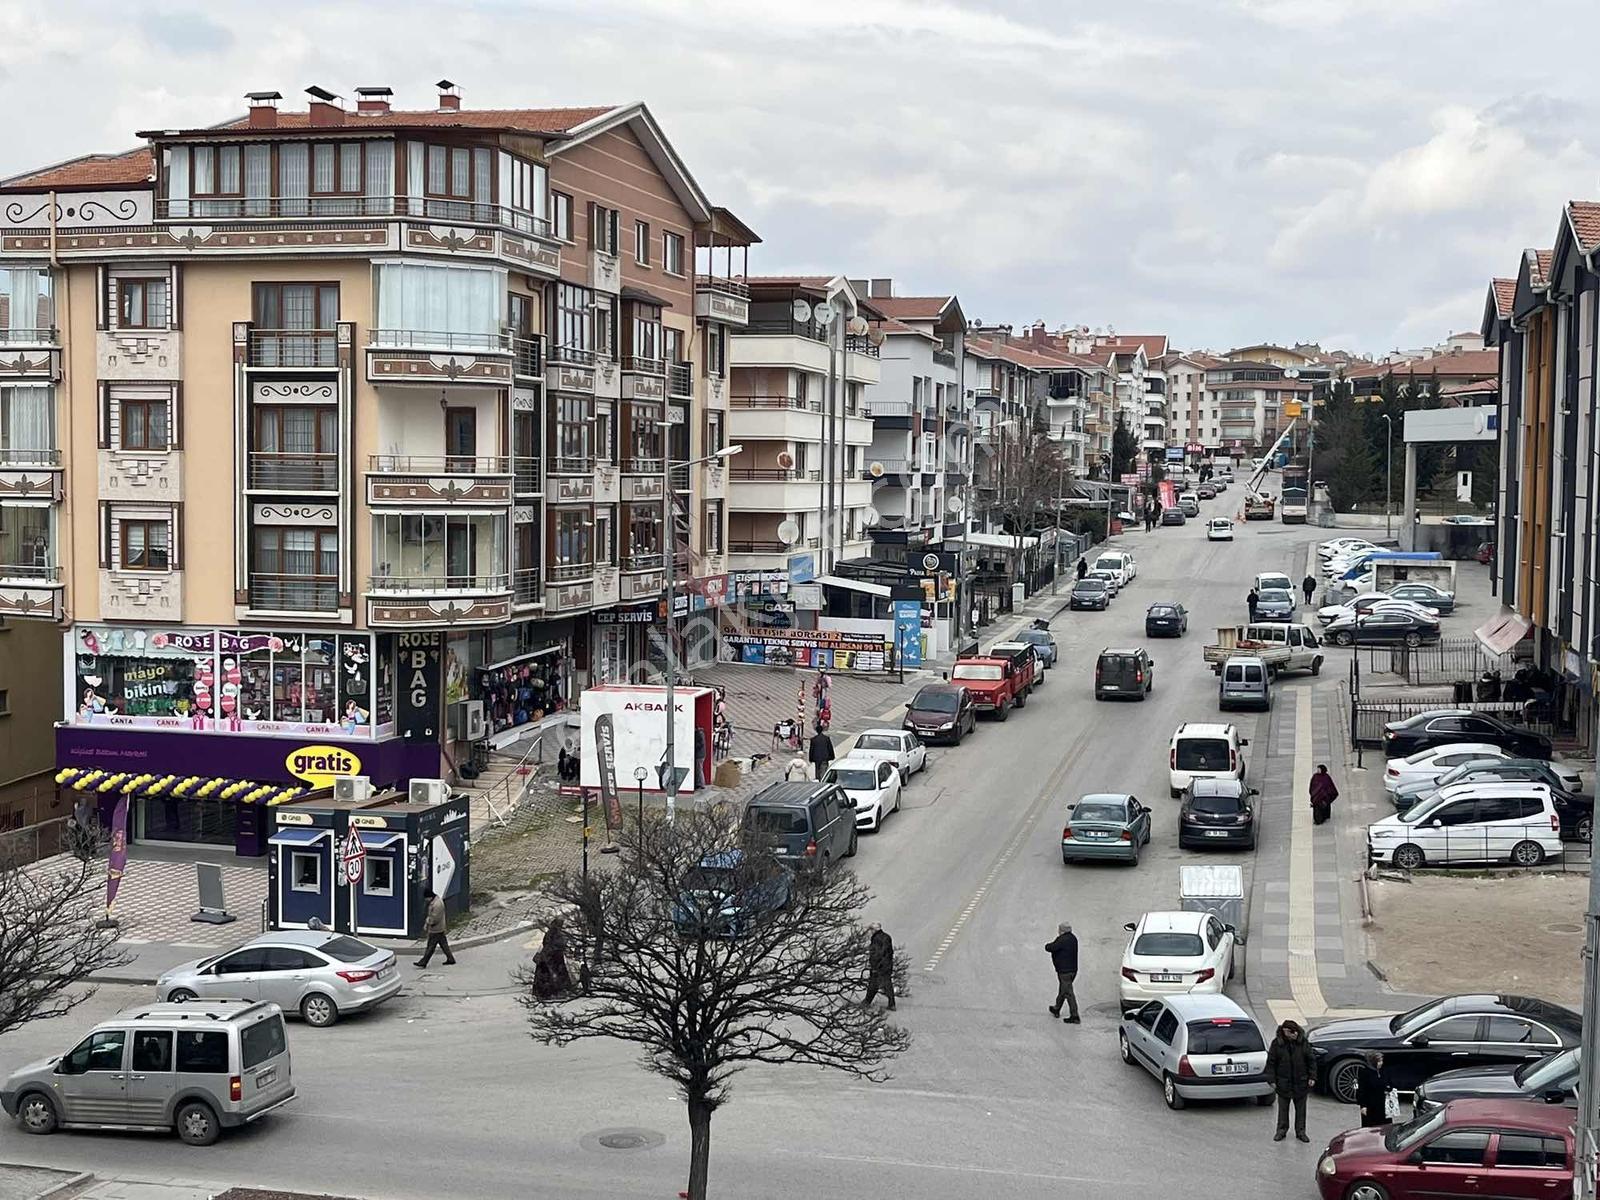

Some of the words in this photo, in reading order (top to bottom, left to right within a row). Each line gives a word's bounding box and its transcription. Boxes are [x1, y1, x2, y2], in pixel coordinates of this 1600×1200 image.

[618, 608, 652, 622] SERVİS
[174, 636, 210, 648] ROSE
[221, 638, 250, 650] BAG
[399, 632, 440, 648] ROSE
[124, 666, 166, 682] mayo
[410, 650, 428, 708] BAG
[124, 680, 167, 700] bikini
[624, 702, 684, 712] AKBAK
[294, 752, 352, 774] gratis
[350, 860, 360, 876] 30
